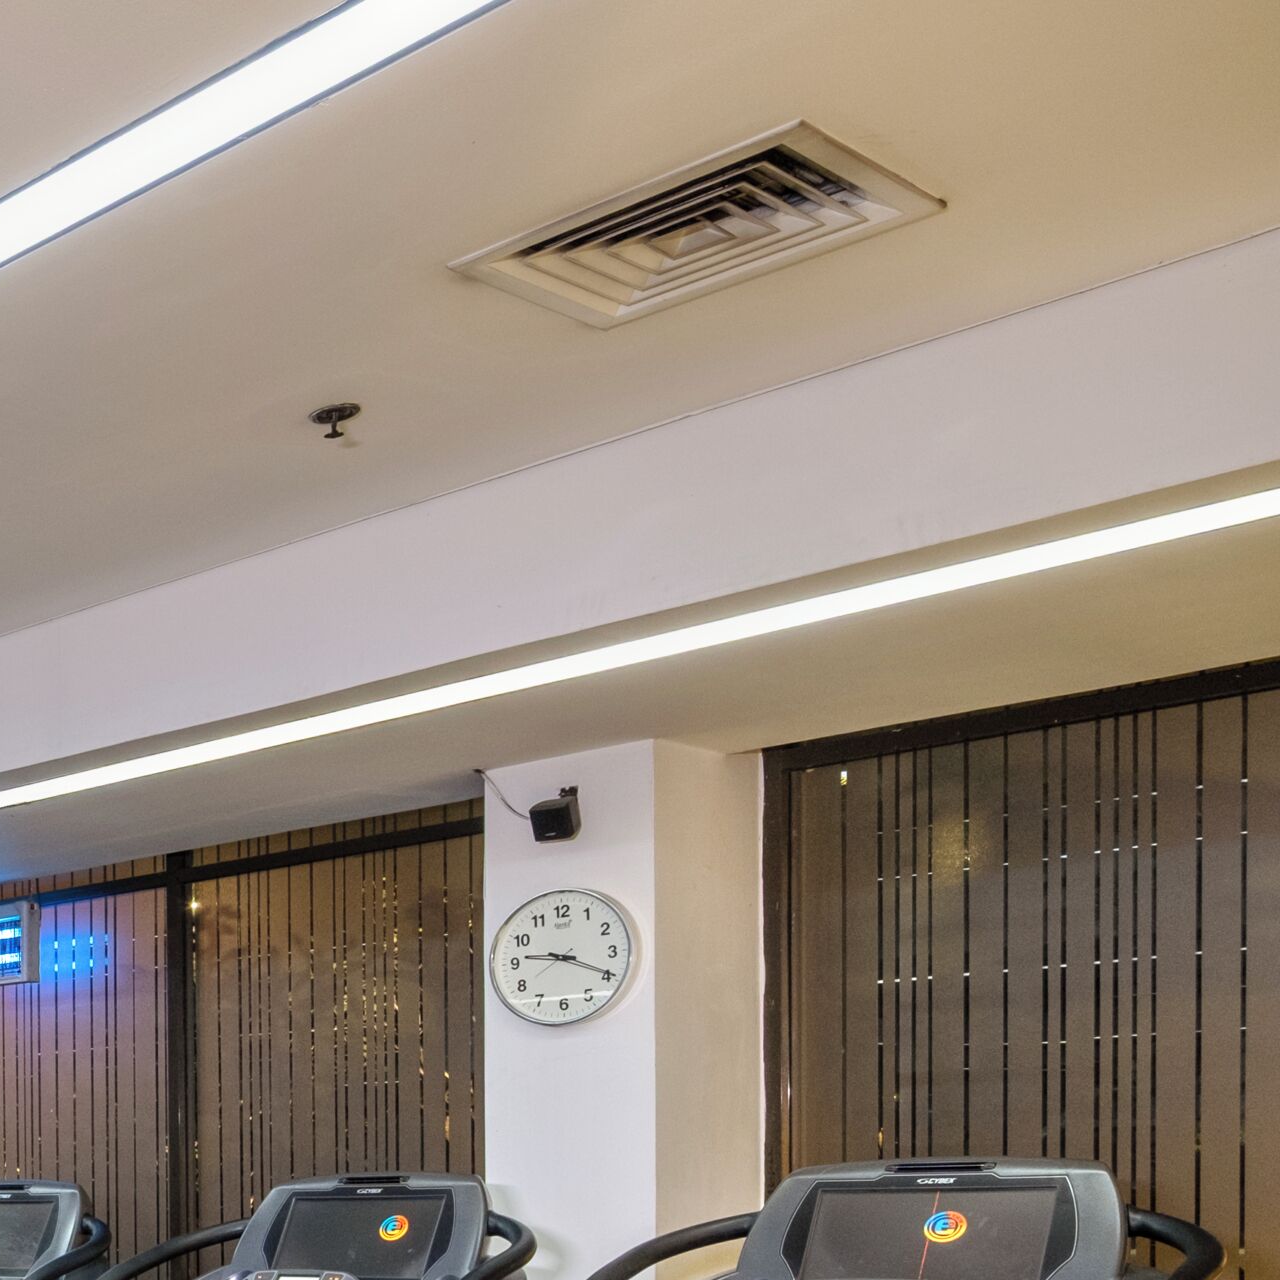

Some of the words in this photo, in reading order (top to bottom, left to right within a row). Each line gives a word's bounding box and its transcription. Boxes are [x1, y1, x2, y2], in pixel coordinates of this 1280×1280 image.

[553, 904, 571, 919] 12
[583, 907, 591, 921] 1
[532, 914, 546, 928] 11
[600, 922, 611, 936] 2
[514, 933, 530, 948] 10
[607, 945, 618, 959] 3
[510, 957, 520, 970] 9
[601, 970, 612, 983] 4
[517, 979, 527, 992] 8
[534, 994, 545, 1008] 7
[583, 988, 594, 1002] 5
[559, 998, 569, 1011] 6
